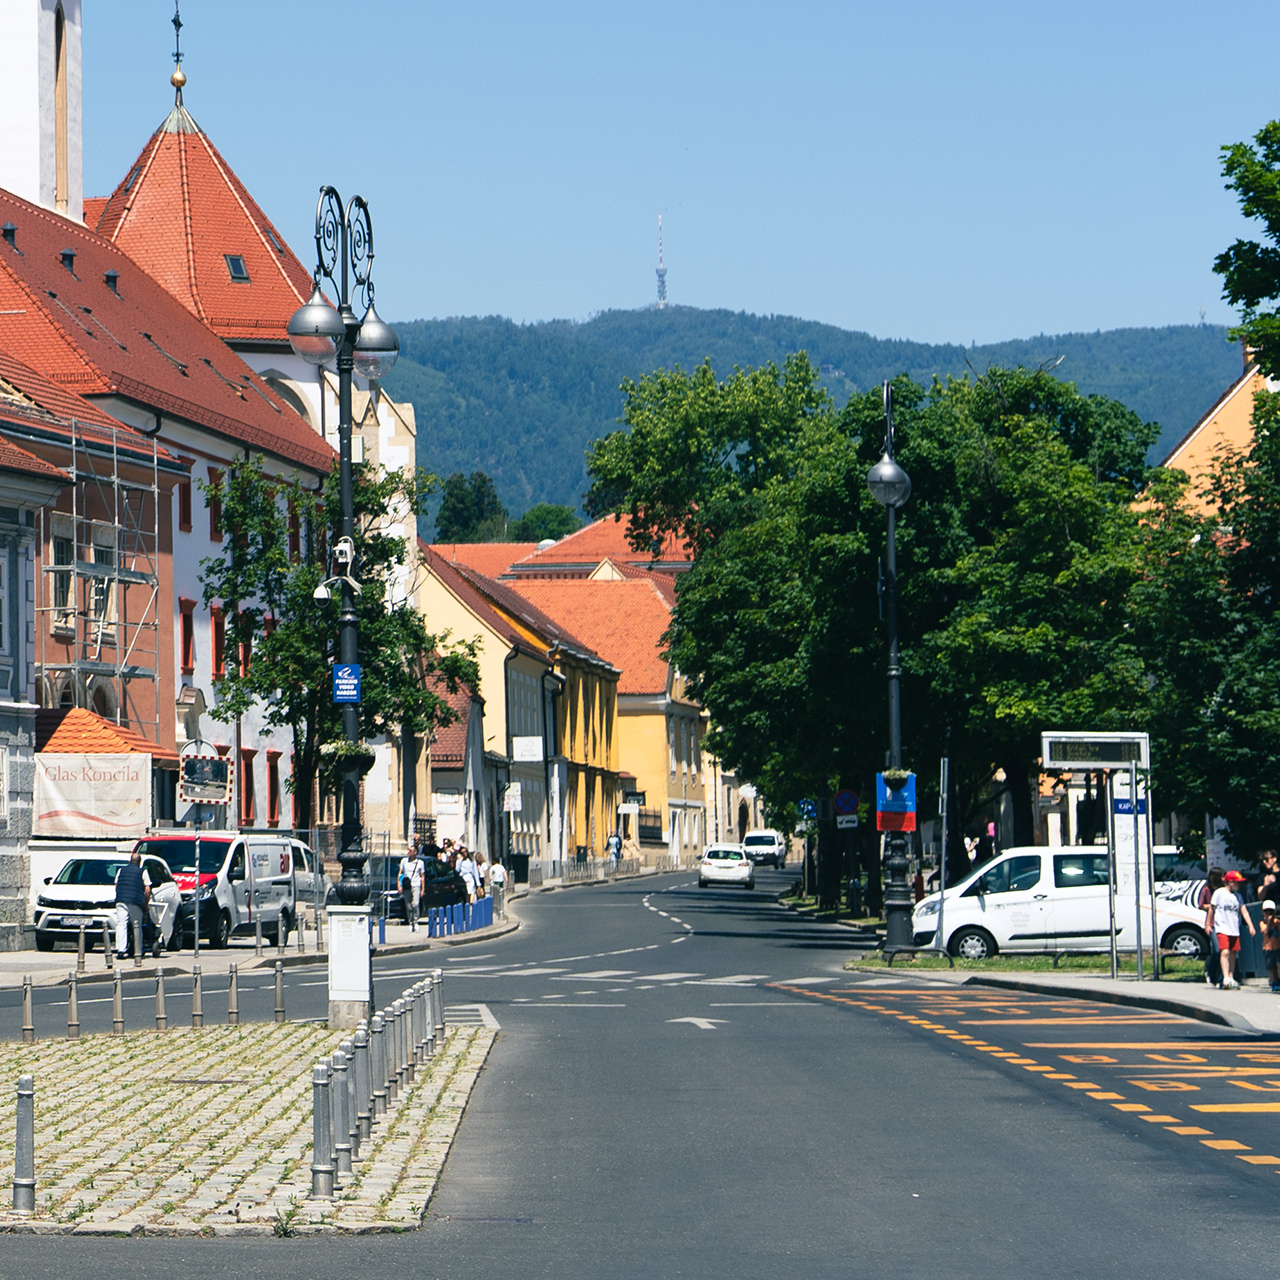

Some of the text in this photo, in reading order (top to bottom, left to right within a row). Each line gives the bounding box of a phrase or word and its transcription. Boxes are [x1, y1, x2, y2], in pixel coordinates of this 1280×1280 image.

[44, 765, 140, 782] Glas Koncila
[1118, 802, 1141, 810] KAPL
